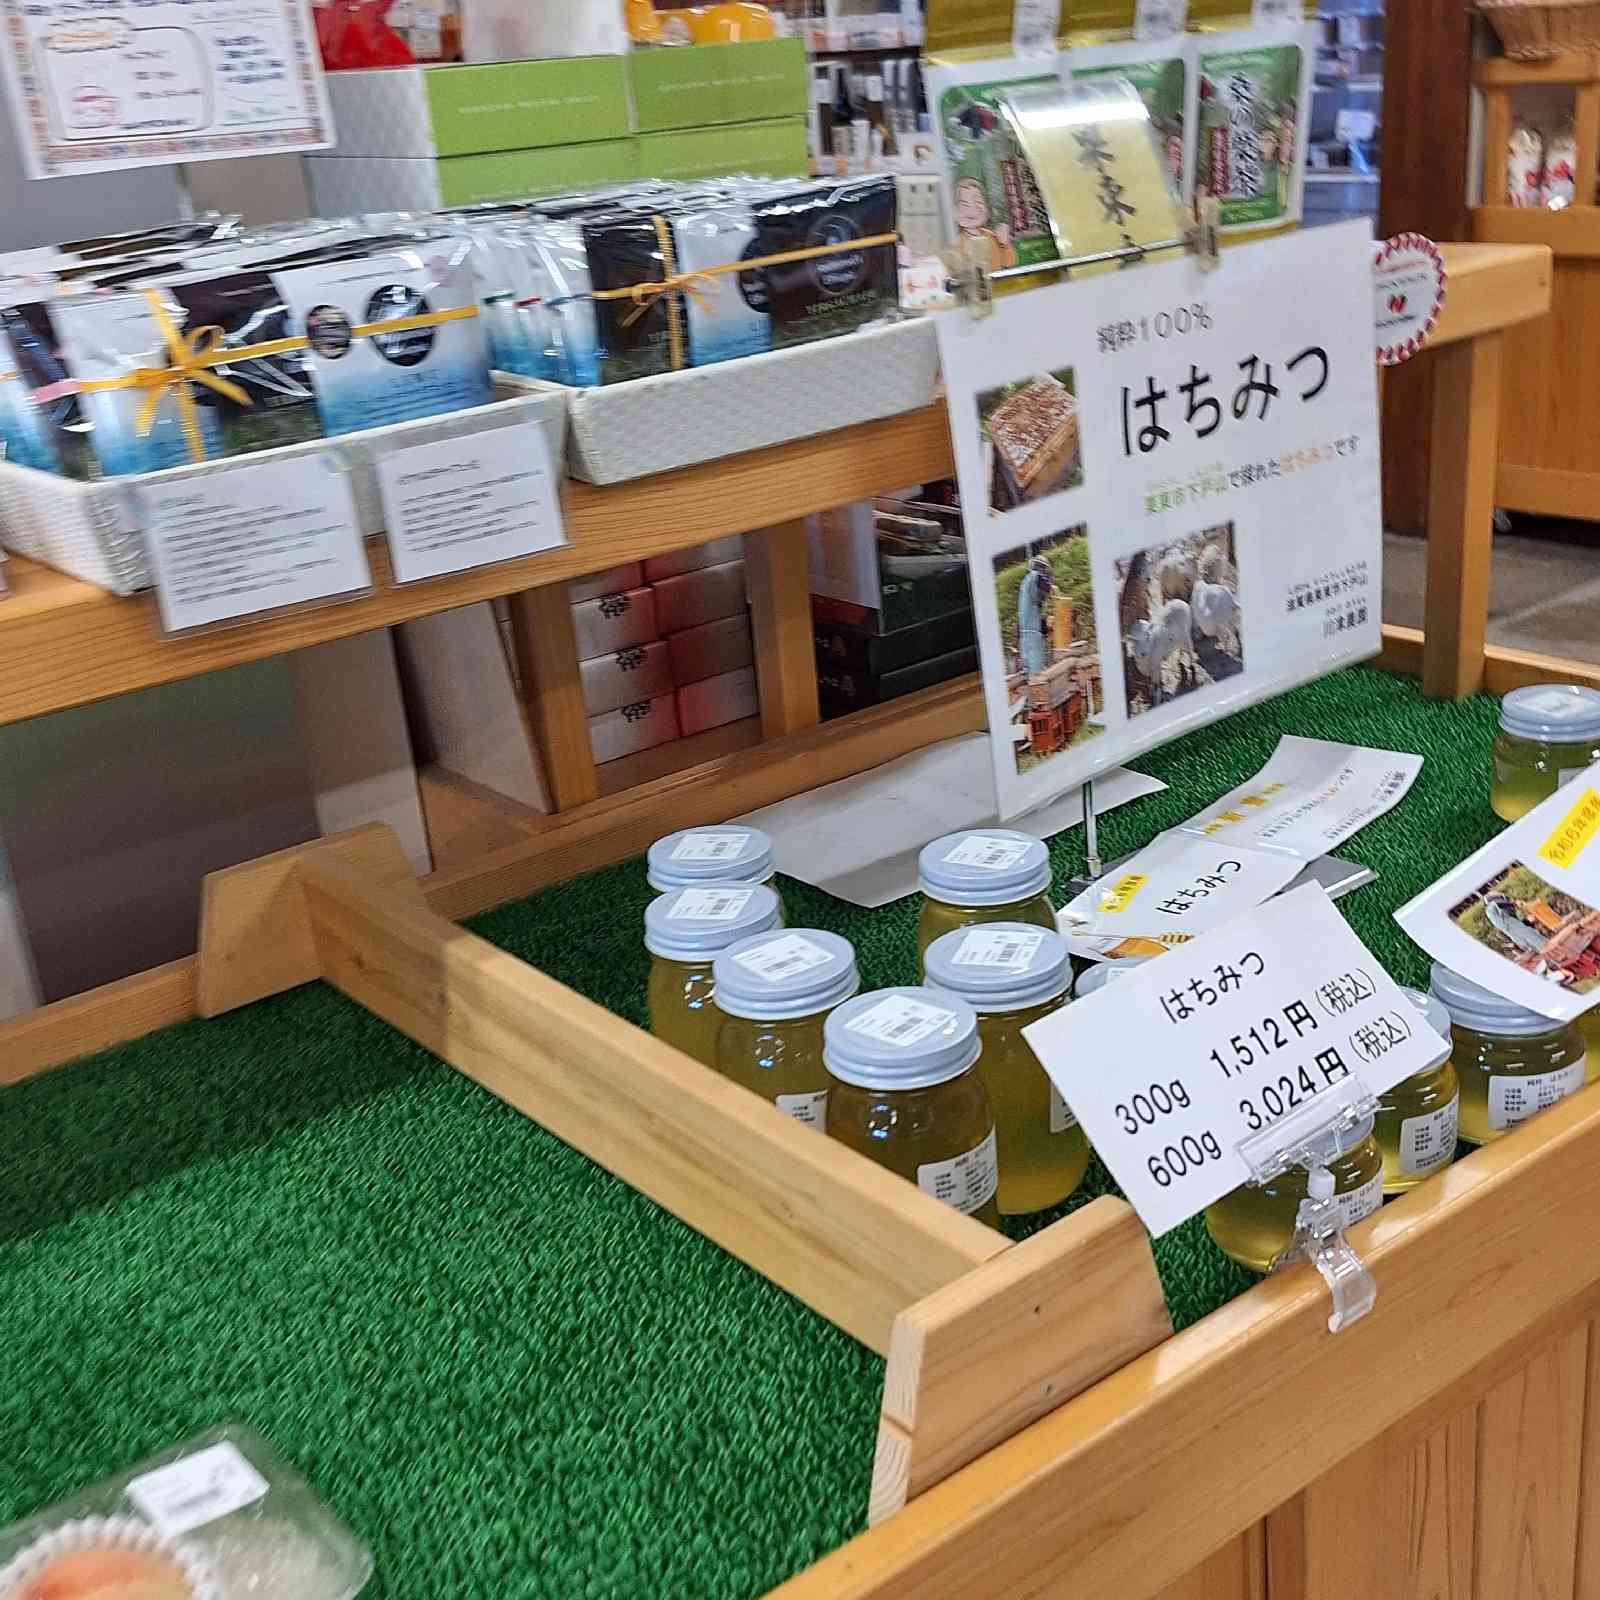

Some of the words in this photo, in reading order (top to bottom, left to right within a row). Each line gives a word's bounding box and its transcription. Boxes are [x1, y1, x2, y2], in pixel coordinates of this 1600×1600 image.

[1120, 346, 1330, 457] はちみつ
[1155, 860, 1241, 915] はちみつ
[1160, 950, 1265, 1024] はちみつ
[1115, 1078, 1191, 1135] 300g
[1147, 1129, 1223, 1187] 600g
